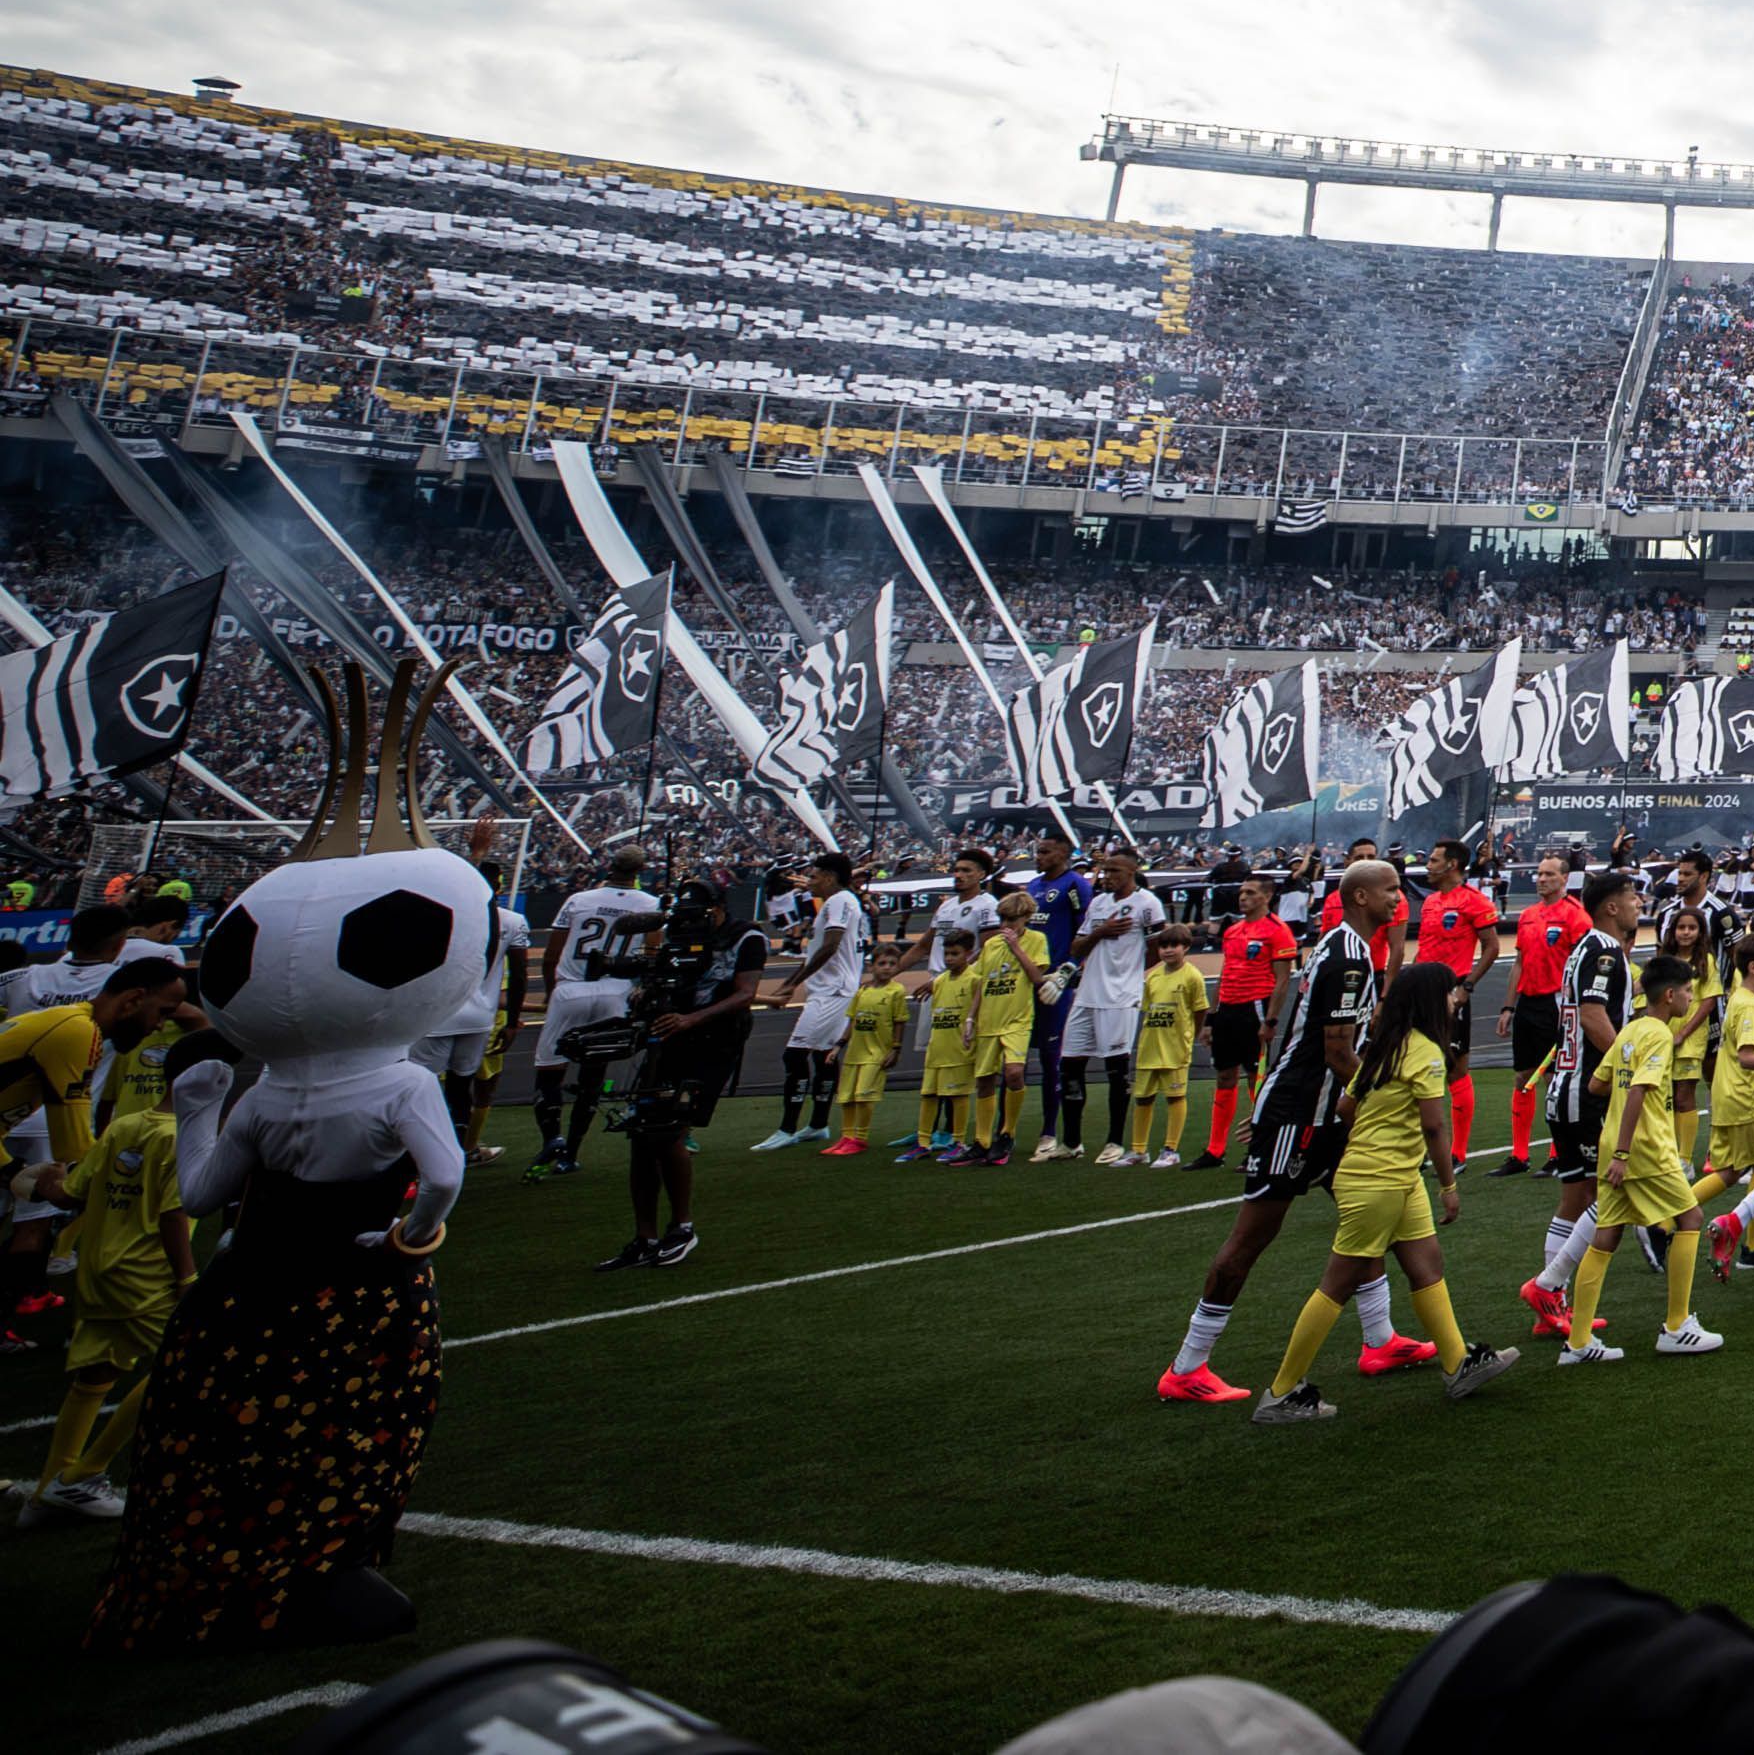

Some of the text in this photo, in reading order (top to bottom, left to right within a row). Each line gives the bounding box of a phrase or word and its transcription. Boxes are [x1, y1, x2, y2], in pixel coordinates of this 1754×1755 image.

[403, 624, 556, 651] BOTAFOGO
[1539, 789, 1740, 810] BUENOS AIRES FINAL 2024
[986, 978, 1016, 988] BLACK
[933, 1015, 960, 1023] BLACK
[1556, 1004, 1578, 1072] 3
